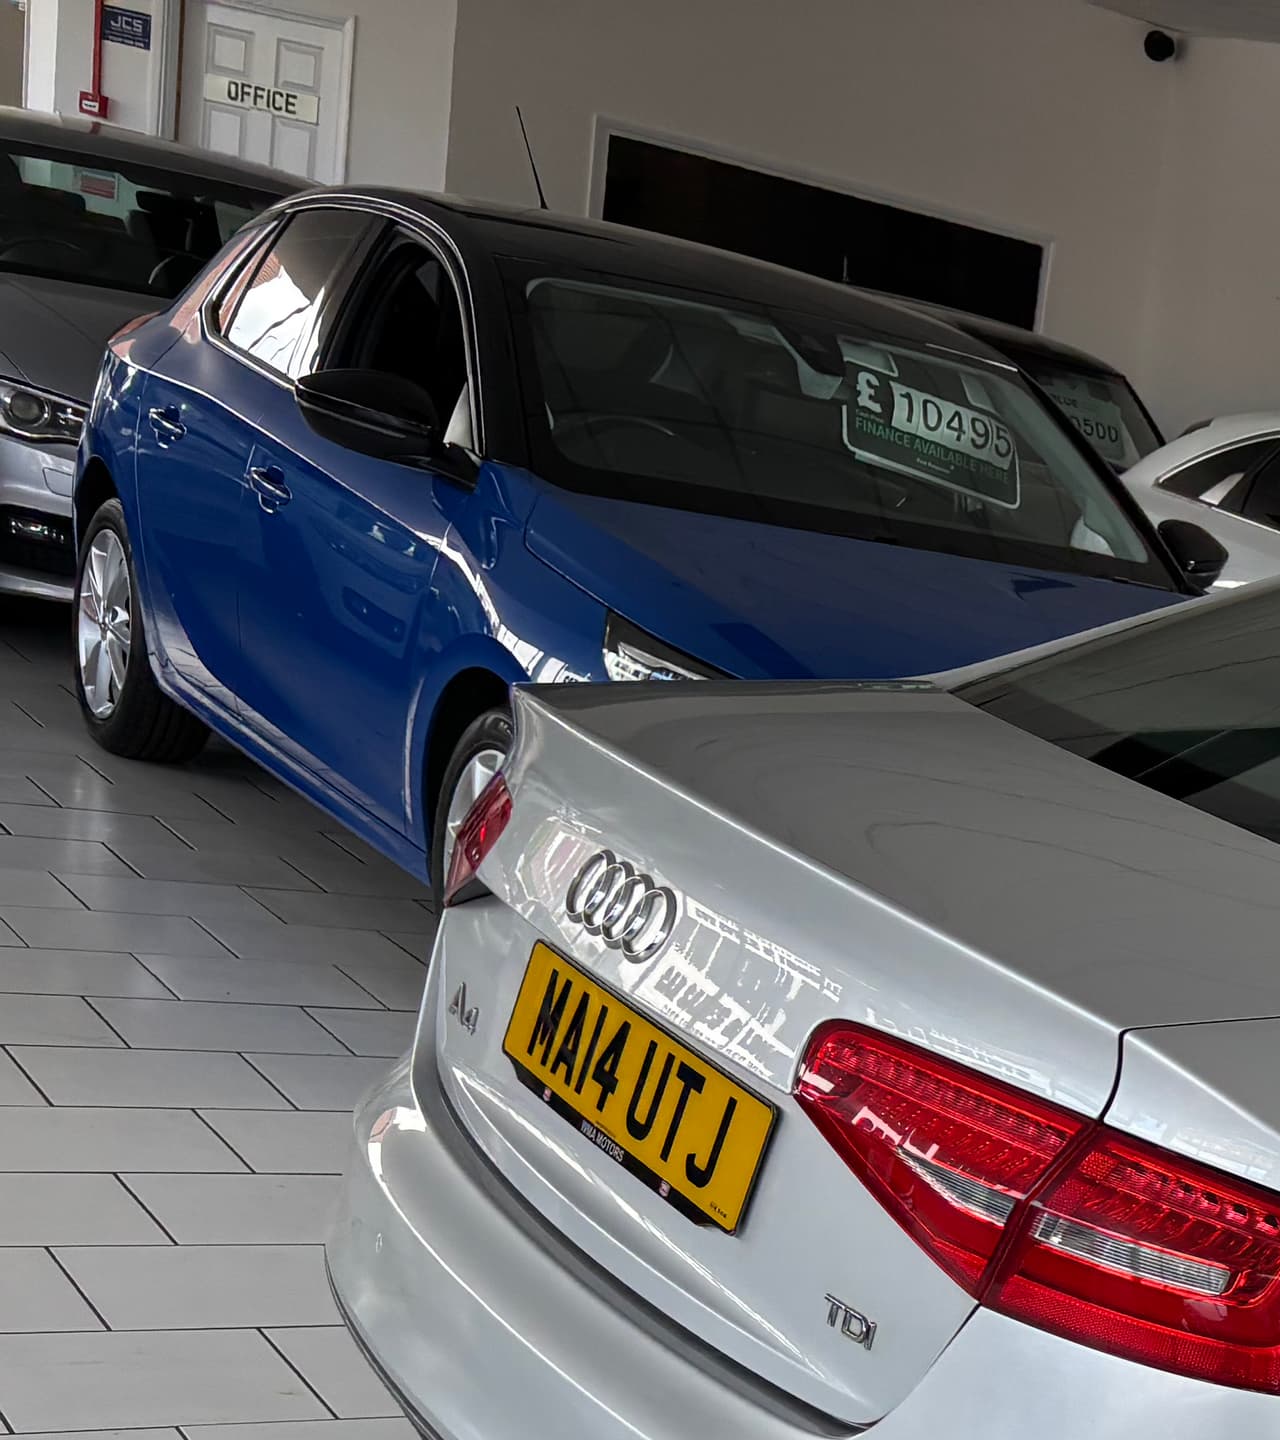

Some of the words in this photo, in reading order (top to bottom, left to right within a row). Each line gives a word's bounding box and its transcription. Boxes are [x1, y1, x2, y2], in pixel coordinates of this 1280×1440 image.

[110, 15, 144, 33] JCS
[227, 80, 298, 115] OFFICE
[855, 415, 911, 448] FINANCE
[913, 437, 977, 473] AVAILABLE
[448, 981, 480, 1036] A4
[526, 968, 632, 1113] MA14
[625, 1040, 738, 1188] UTJ
[595, 1133, 625, 1163] MOTORS
[823, 1292, 878, 1352] TDI
